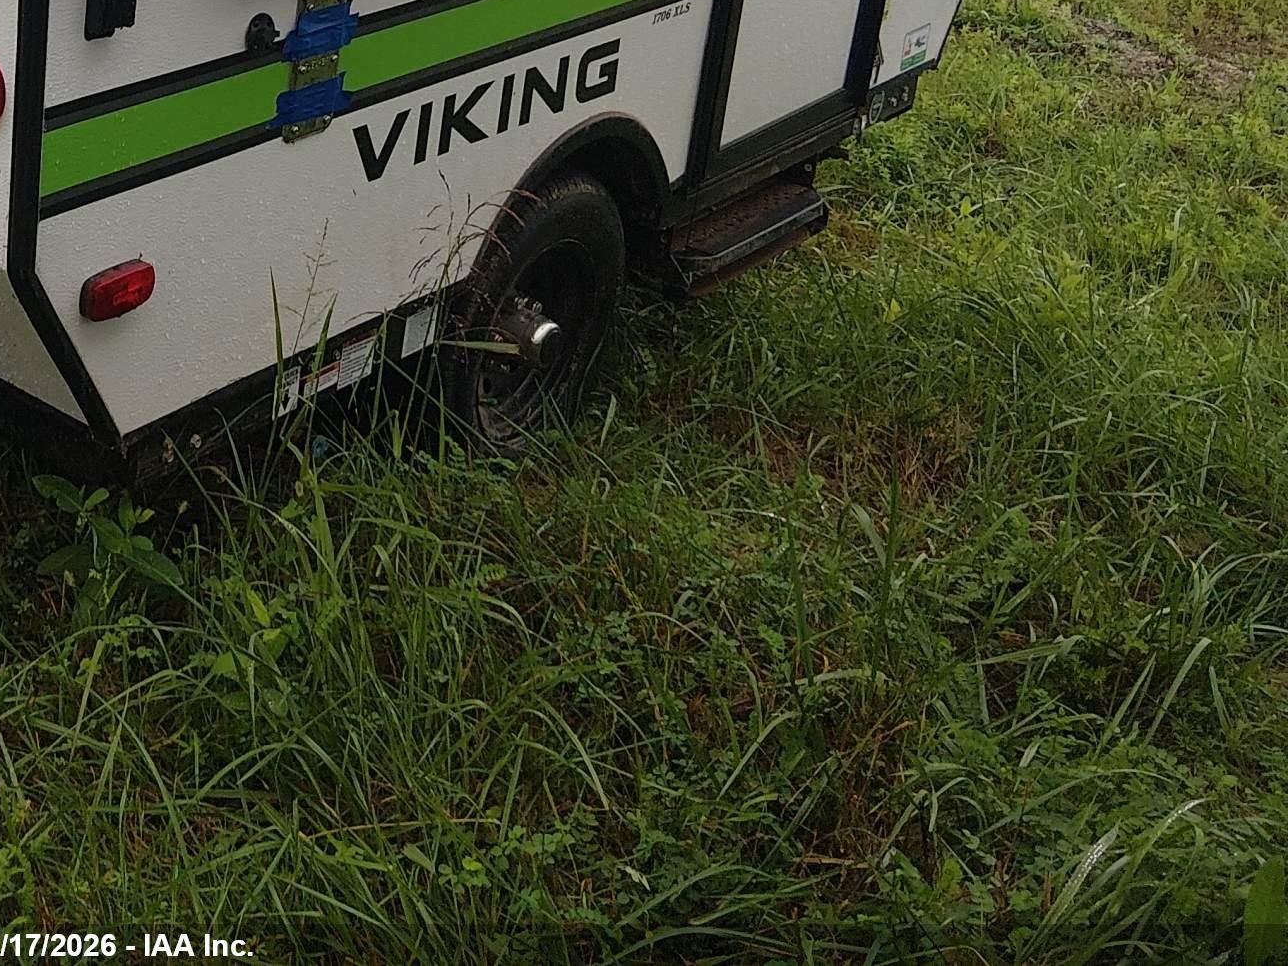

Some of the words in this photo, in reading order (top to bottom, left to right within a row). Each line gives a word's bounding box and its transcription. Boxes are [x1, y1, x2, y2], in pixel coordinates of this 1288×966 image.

[652, 8, 672, 26] 1706
[672, 1, 692, 18] XLS
[352, 38, 621, 183] VIKING
